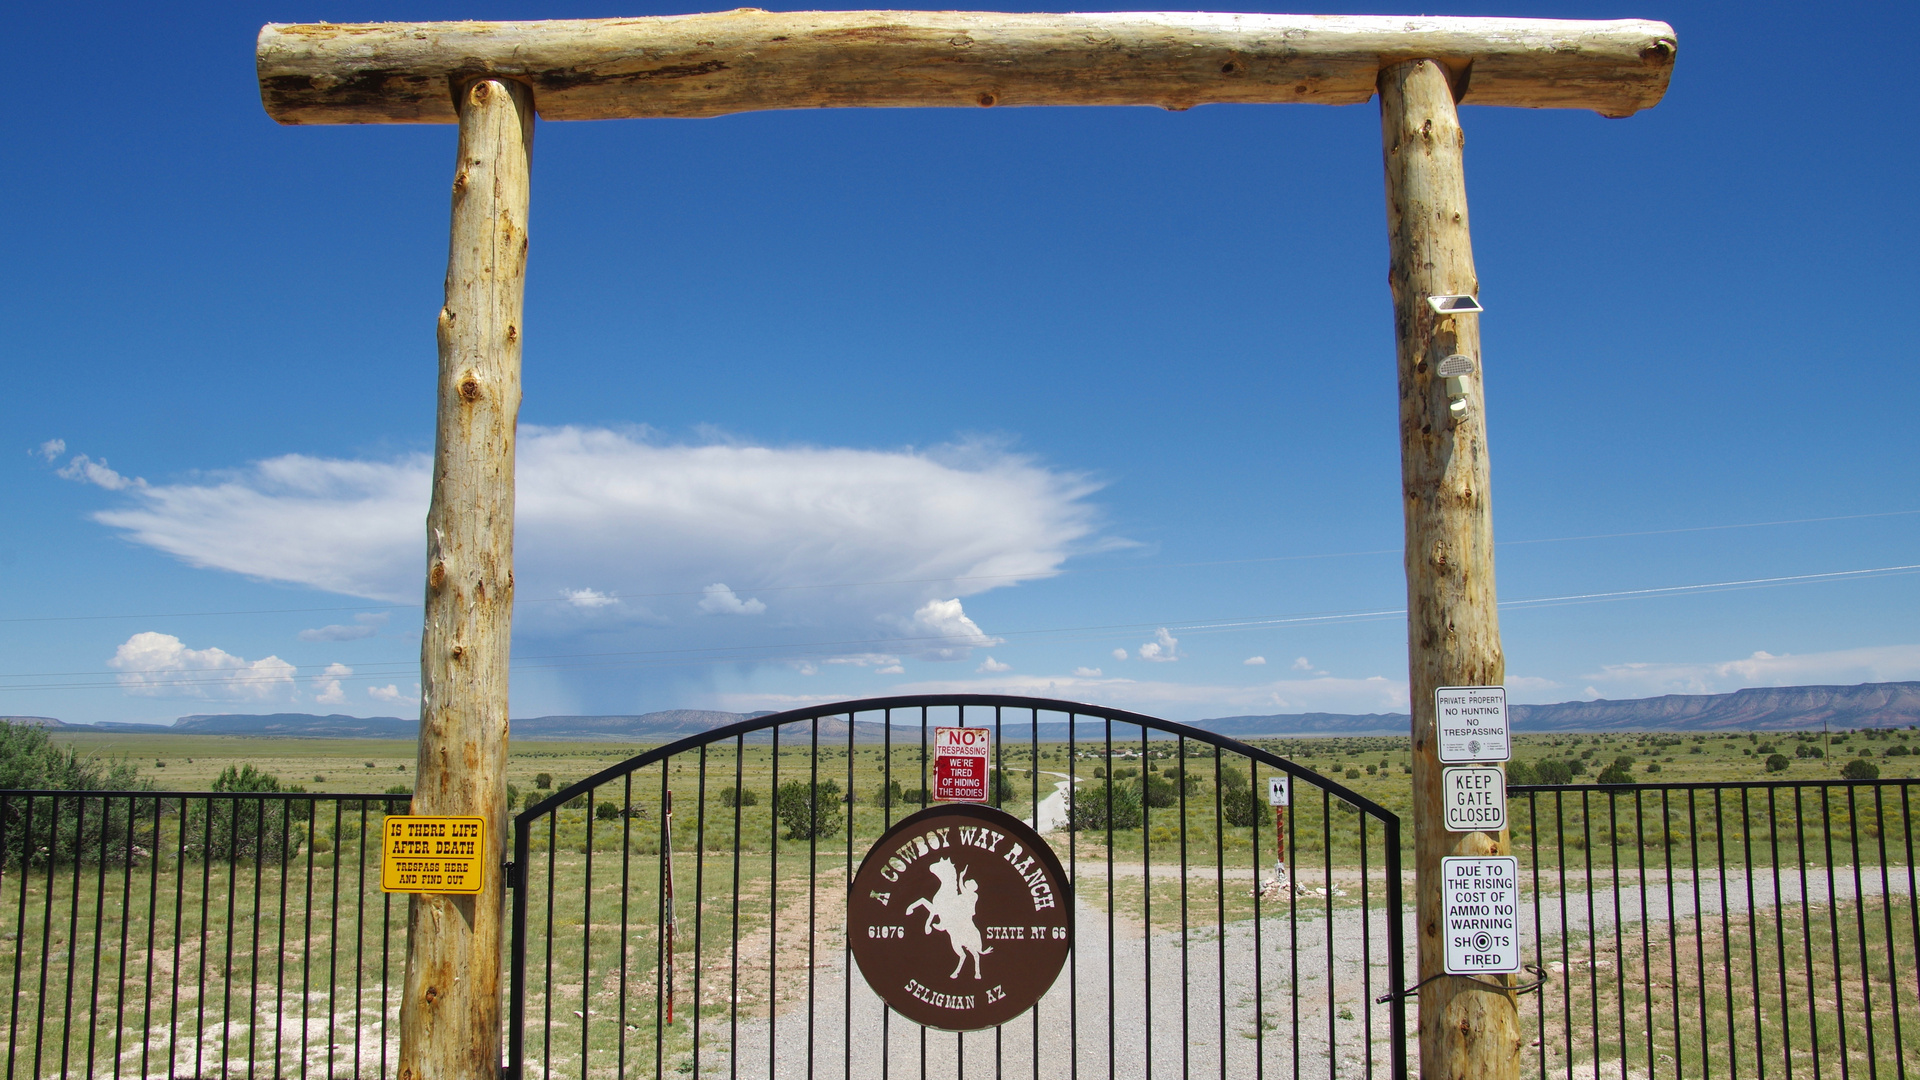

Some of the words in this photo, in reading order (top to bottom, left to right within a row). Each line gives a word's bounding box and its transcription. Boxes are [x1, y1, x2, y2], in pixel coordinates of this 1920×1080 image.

[1440, 697, 1466, 705] PRIVATE
[1469, 696, 1503, 704] PROPERTY
[1445, 708, 1458, 716] NO
[1461, 707, 1499, 715] HUNTING
[1444, 728, 1504, 736] TRESPASSING
[949, 731, 975, 745] NO
[938, 746, 986, 755] TRESPASSING
[950, 759, 974, 767] WE'RE
[951, 768, 972, 777] TIRED
[942, 778, 952, 786] OF
[954, 778, 980, 787] HIDING
[1456, 775, 1491, 789] KEEP
[939, 788, 953, 796] THE
[955, 788, 983, 797] BODIES
[1457, 792, 1492, 805] GATE
[1450, 808, 1500, 822] CLOSED
[391, 824, 402, 836] IS
[408, 824, 445, 836] THERE
[452, 824, 478, 837] LIFE
[958, 826, 1004, 852] WAY
[392, 841, 430, 854] AFTER
[436, 842, 474, 854] DEATH
[880, 827, 950, 882] COWBOY
[396, 862, 440, 872] TRESPASS
[444, 863, 468, 872] HERE
[1457, 866, 1481, 876] DUE
[1486, 866, 1502, 876] TO
[399, 874, 416, 884] AND
[422, 875, 442, 884] FIND
[447, 876, 464, 884] OUT
[1004, 842, 1054, 912] RANCH
[1448, 880, 1470, 889] THE
[1474, 879, 1512, 889] RISING
[870, 890, 891, 906] A
[1456, 892, 1486, 902] COST
[1490, 892, 1505, 902] OF
[1450, 906, 1490, 916] AMMO
[1495, 905, 1512, 915] NO
[1451, 919, 1512, 929] WARNING
[868, 926, 904, 939] 61076
[986, 926, 1024, 940] STATE
[1030, 926, 1047, 940] RT
[1052, 926, 1066, 940] 66
[1464, 955, 1501, 965] FIRED
[904, 978, 975, 1010] SELIGMAN
[986, 985, 1006, 1004] AZ
